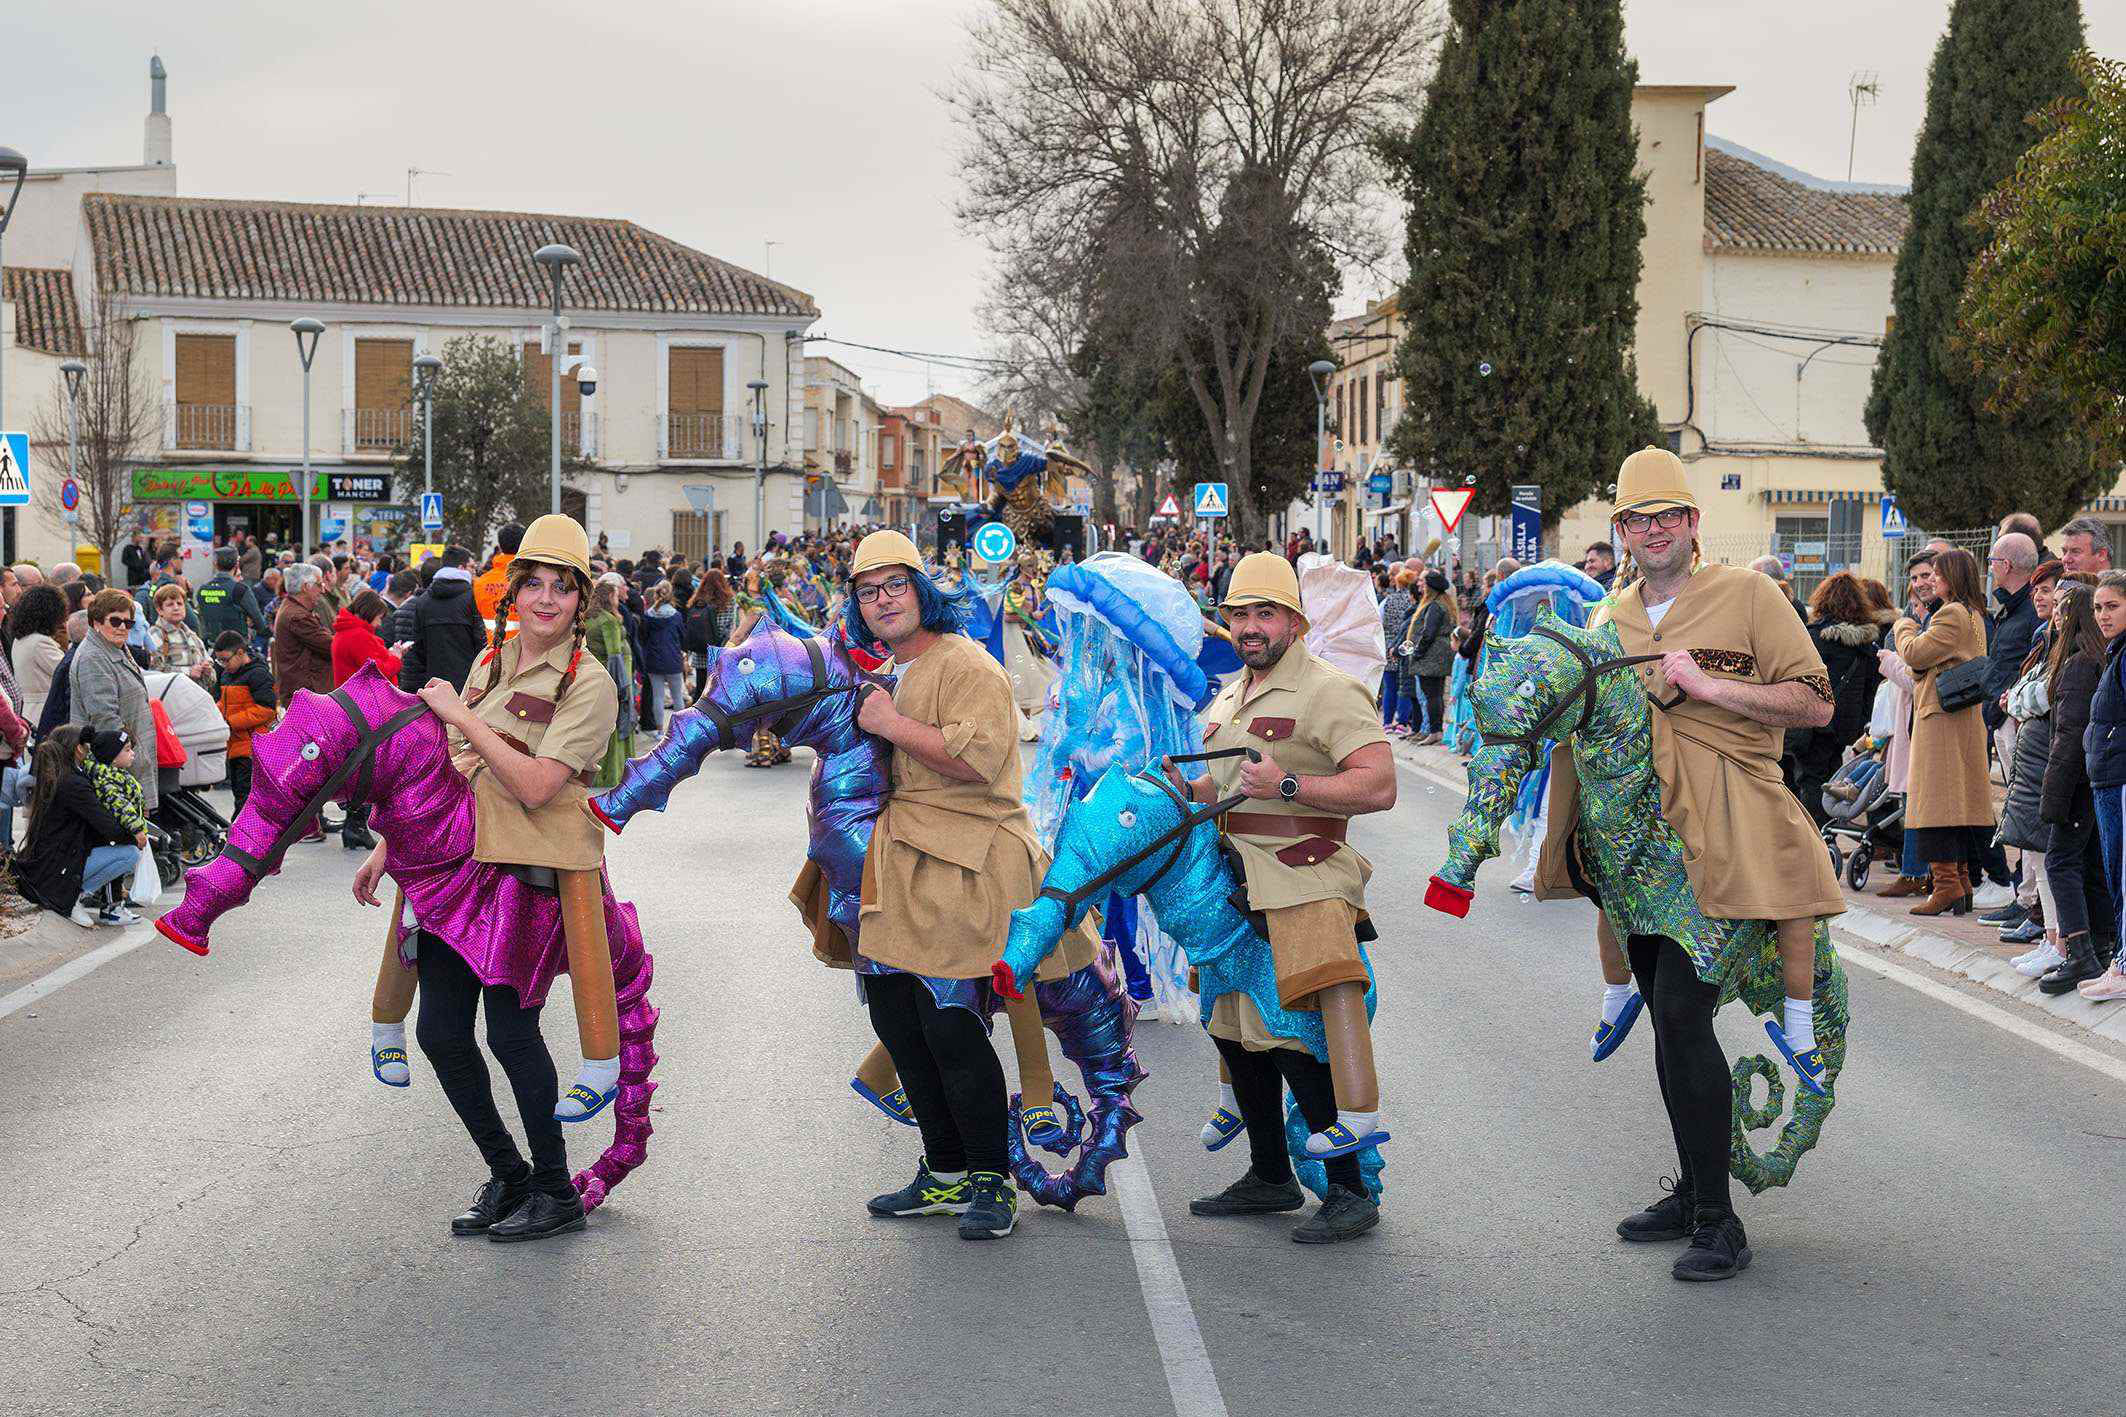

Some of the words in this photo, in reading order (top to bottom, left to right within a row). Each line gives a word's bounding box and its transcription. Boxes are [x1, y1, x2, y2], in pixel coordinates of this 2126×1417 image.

[332, 477, 383, 491] TONER
[379, 1051, 408, 1062] Supe
[567, 1088, 594, 1101] uper
[1022, 1110, 1057, 1127] Super
